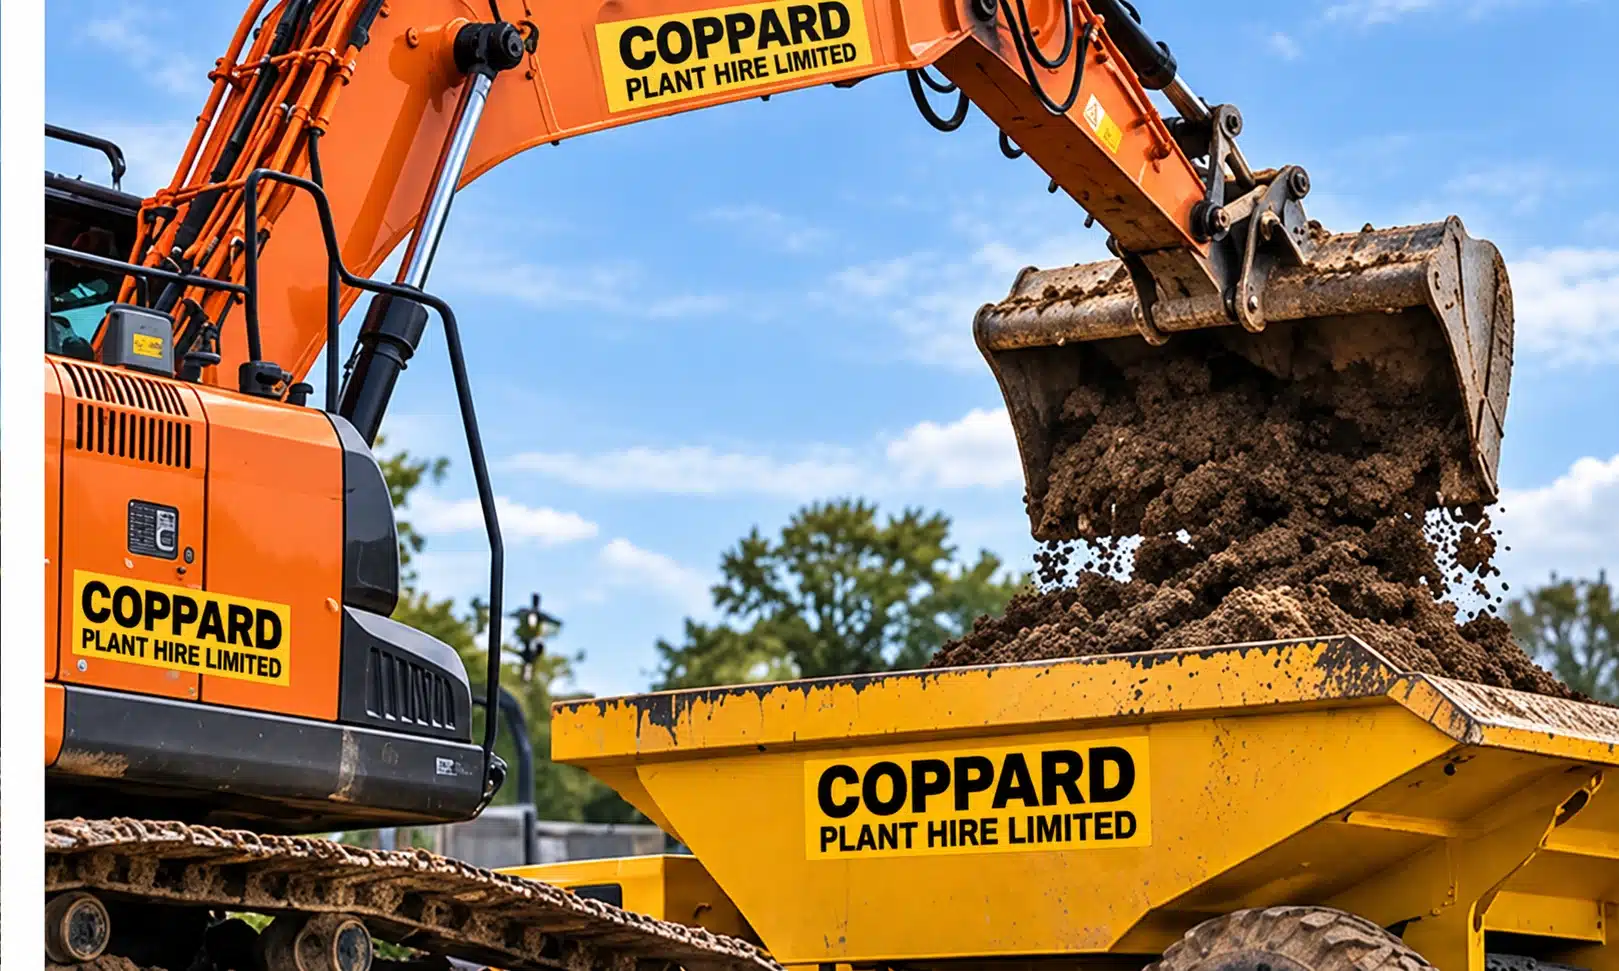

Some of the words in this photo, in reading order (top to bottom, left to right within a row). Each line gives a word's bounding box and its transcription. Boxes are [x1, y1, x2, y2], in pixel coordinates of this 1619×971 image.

[619, 1, 851, 70] COPPARD
[626, 66, 706, 101] PLANT
[714, 56, 770, 86] HIRE
[774, 43, 857, 75] LIMITED
[82, 581, 282, 650] COPPARD
[83, 628, 149, 658] PLANT
[154, 640, 200, 667] HIRE
[206, 648, 282, 678] LIMITED
[818, 747, 1136, 819] COPPARD
[820, 822, 919, 853] PLANT
[928, 818, 999, 848] HIRE
[1008, 811, 1137, 845] LIMITED
